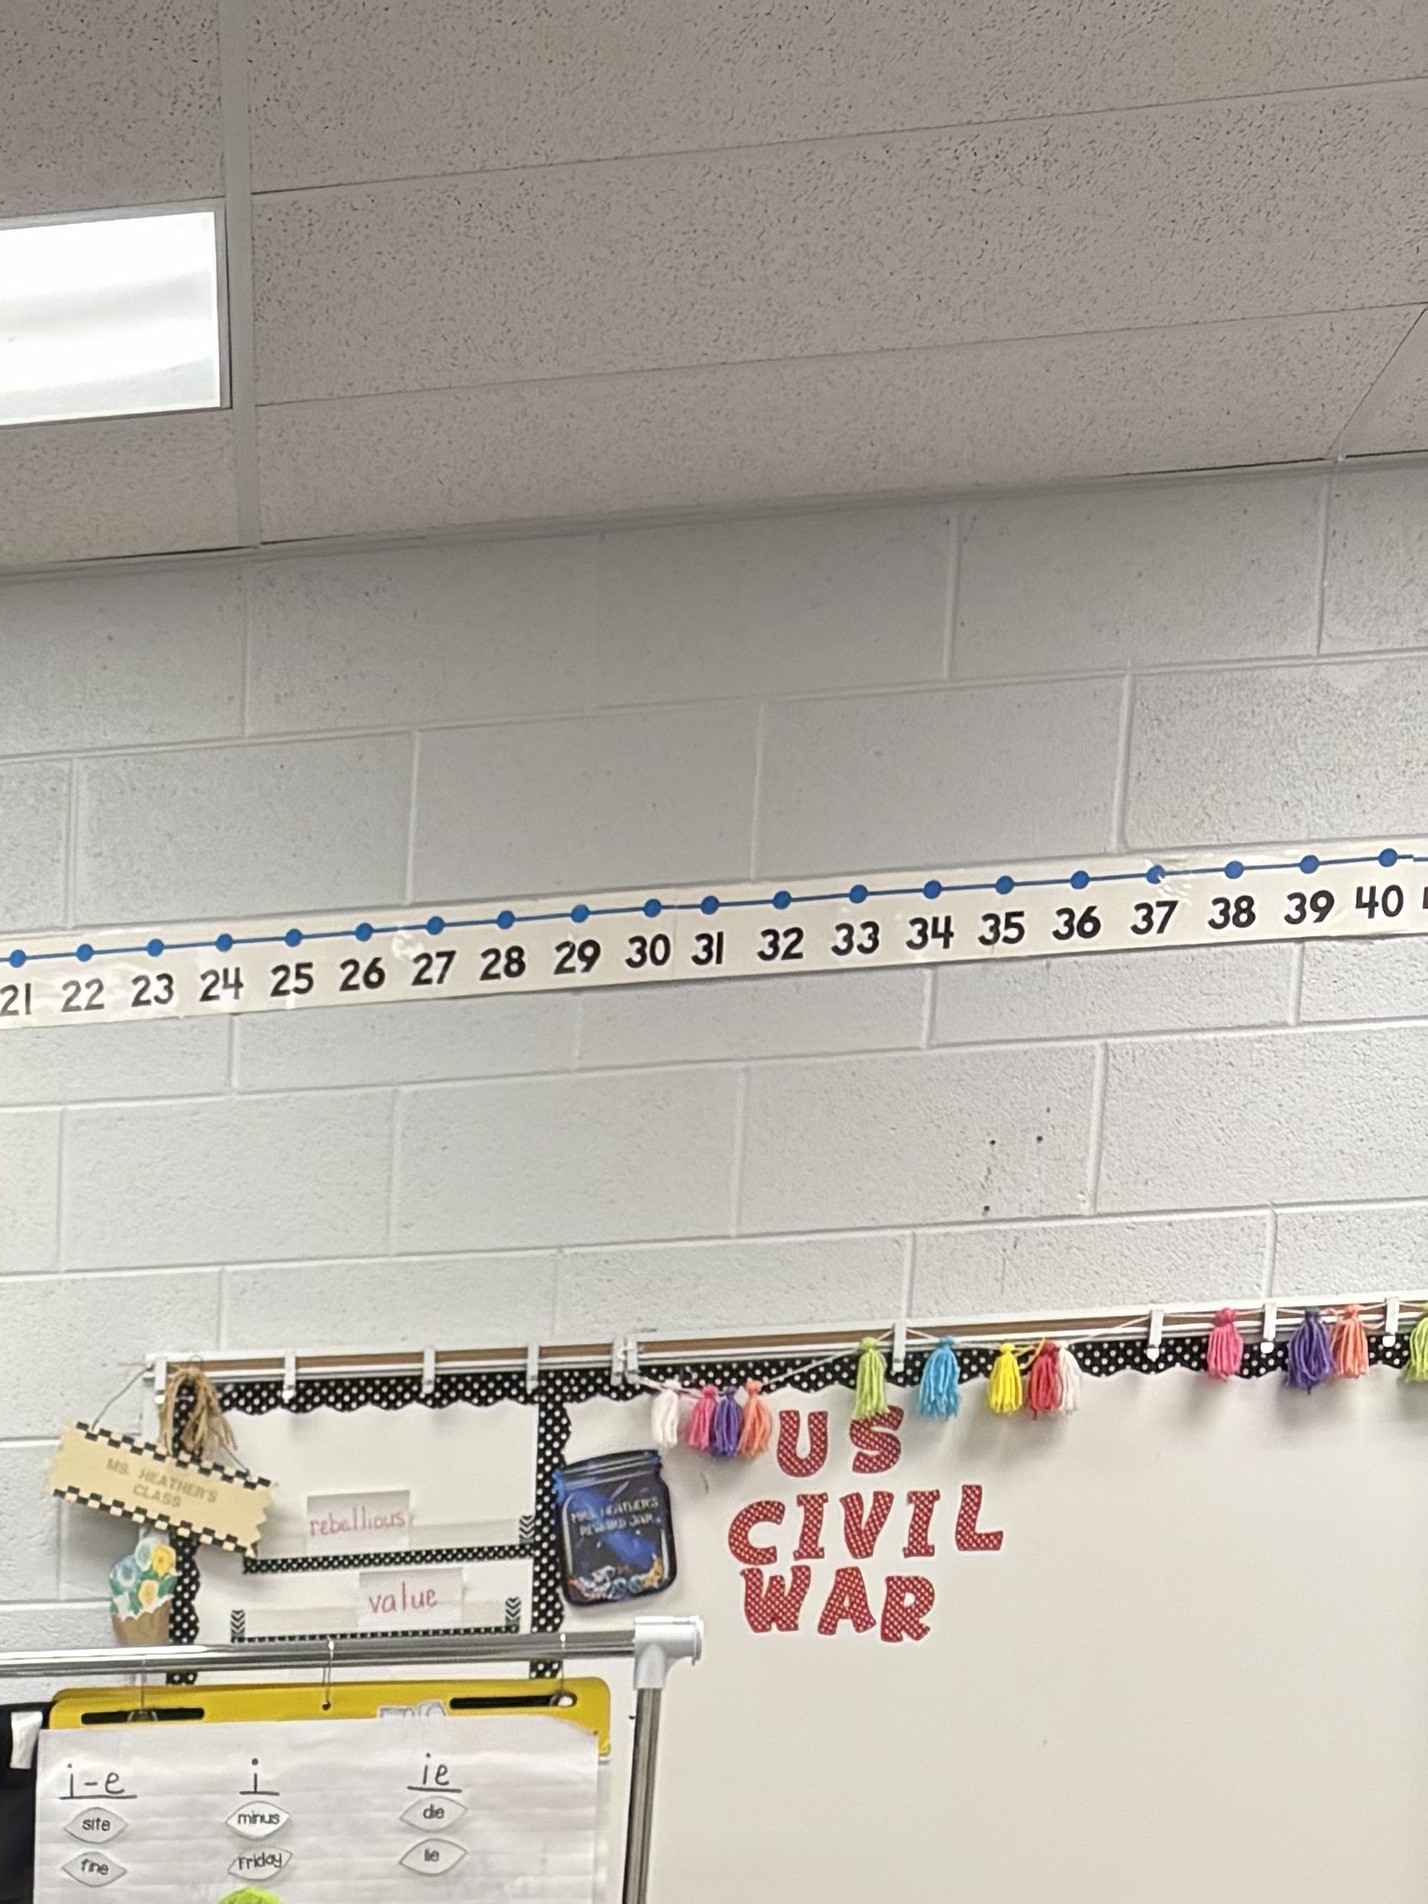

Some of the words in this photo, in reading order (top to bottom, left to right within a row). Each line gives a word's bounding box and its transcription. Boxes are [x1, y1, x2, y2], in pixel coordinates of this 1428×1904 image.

[1, 984, 30, 1014] 21
[61, 978, 104, 1013] 22
[132, 974, 173, 1006] 23
[200, 968, 243, 1001] 24
[271, 962, 313, 996] 25
[340, 957, 385, 991] 26
[412, 950, 456, 985] 27
[480, 946, 525, 980] 28
[554, 940, 600, 974] 29
[626, 934, 670, 968] 30
[692, 932, 723, 965] 31
[757, 927, 803, 961] 32
[832, 921, 879, 955] 33
[906, 916, 954, 949] 34
[978, 911, 1024, 945] 35
[1053, 906, 1101, 940] 36
[1131, 901, 1178, 934] 37
[1208, 896, 1255, 929] 38
[1284, 890, 1334, 924] 39
[1356, 885, 1403, 918] 40
[133, 1484, 182, 1508] CLASS
[310, 1506, 406, 1536] rebellious
[727, 1484, 1005, 1564] CIVIL
[369, 1581, 437, 1614] value
[740, 1565, 937, 1644] WAR
[421, 1752, 450, 1786] ie
[81, 1816, 111, 1832] site
[238, 1811, 280, 1824] minus
[423, 1805, 444, 1819] die
[237, 1853, 283, 1871] Friday
